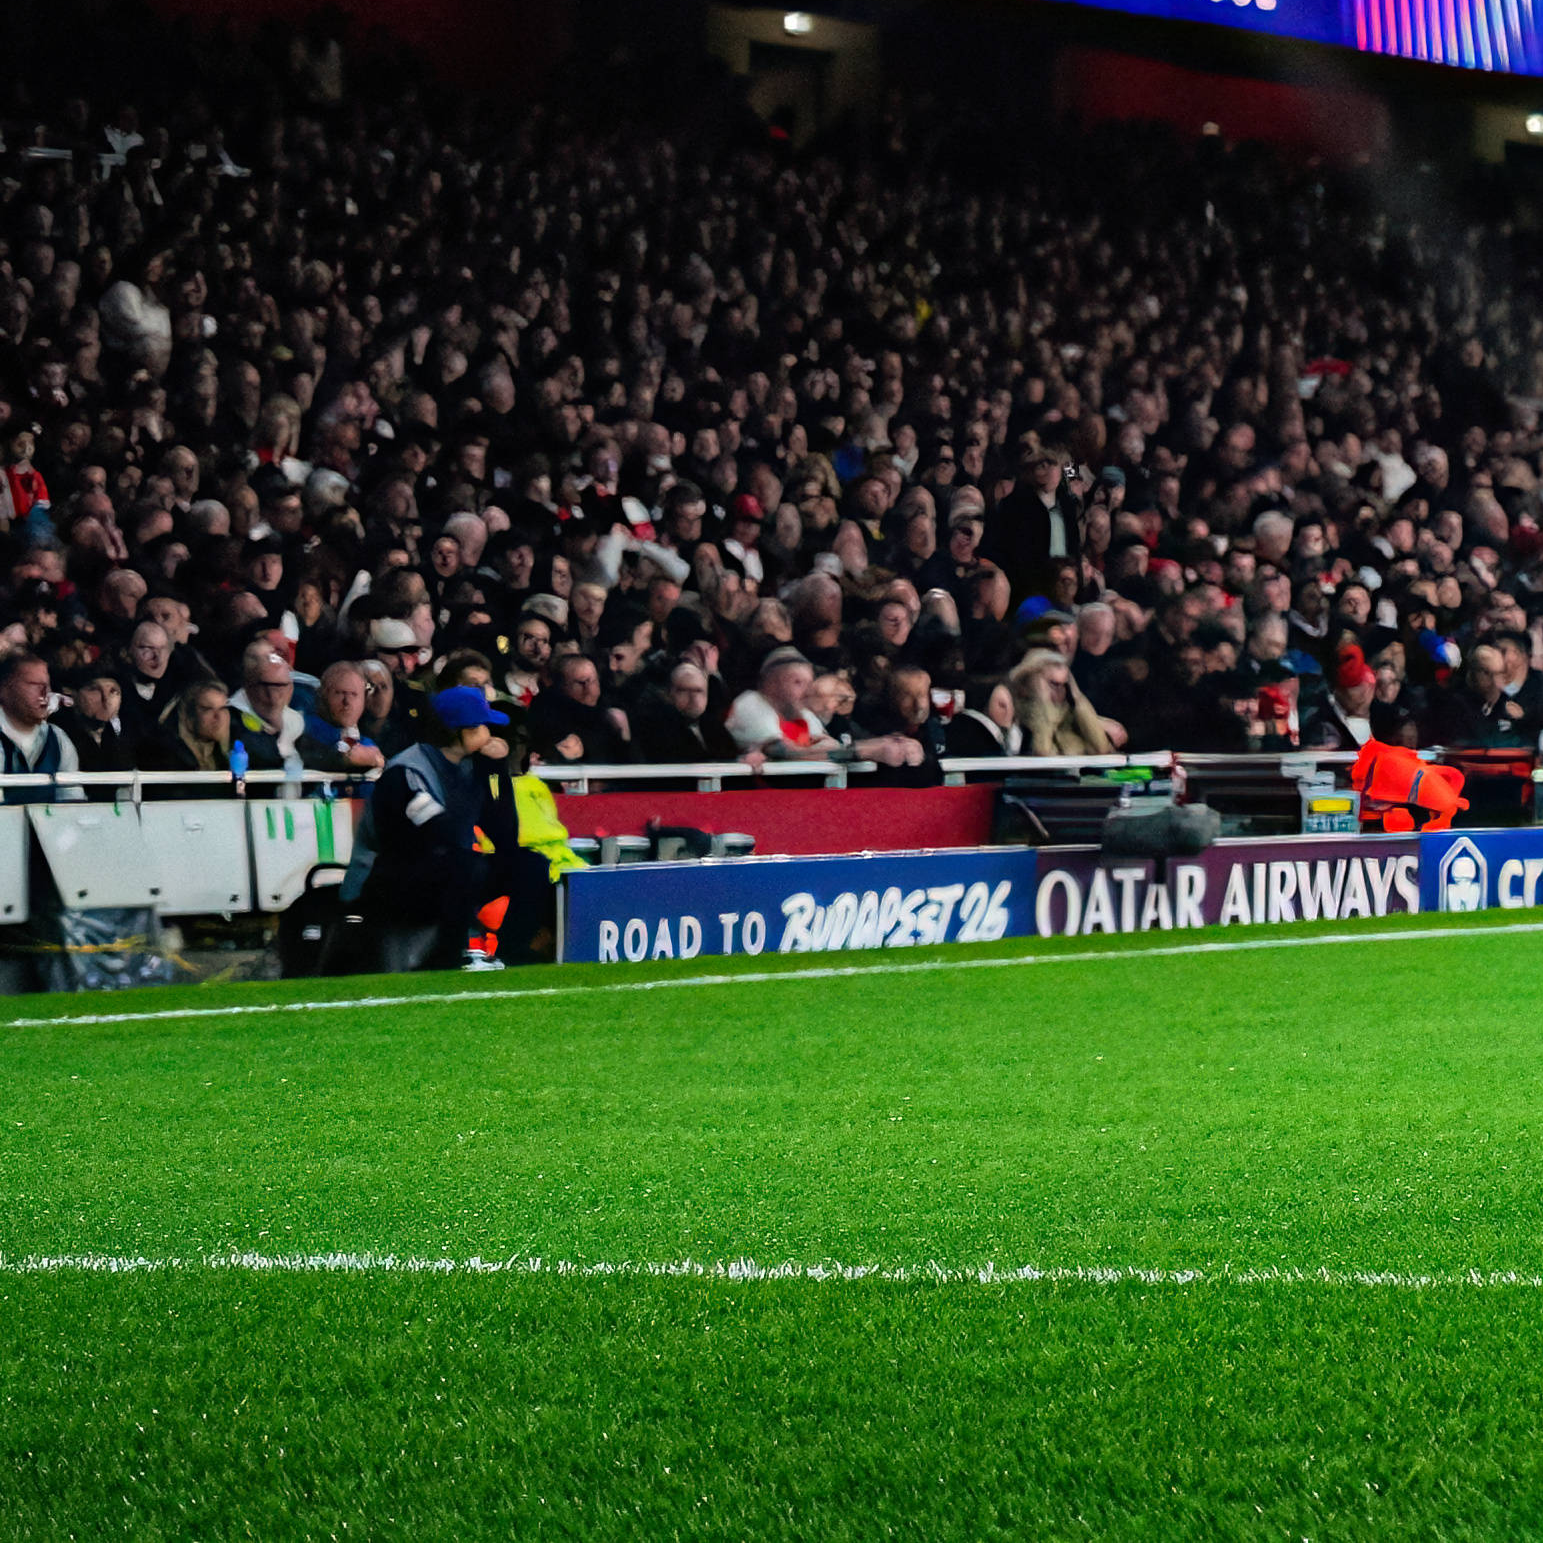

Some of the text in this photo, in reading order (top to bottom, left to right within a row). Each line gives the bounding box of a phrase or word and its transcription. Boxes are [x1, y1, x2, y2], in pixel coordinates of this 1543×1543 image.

[1035, 855, 1420, 938] QATAR AIRWAYS
[600, 915, 702, 963] ROAD
[719, 911, 766, 956] TO
